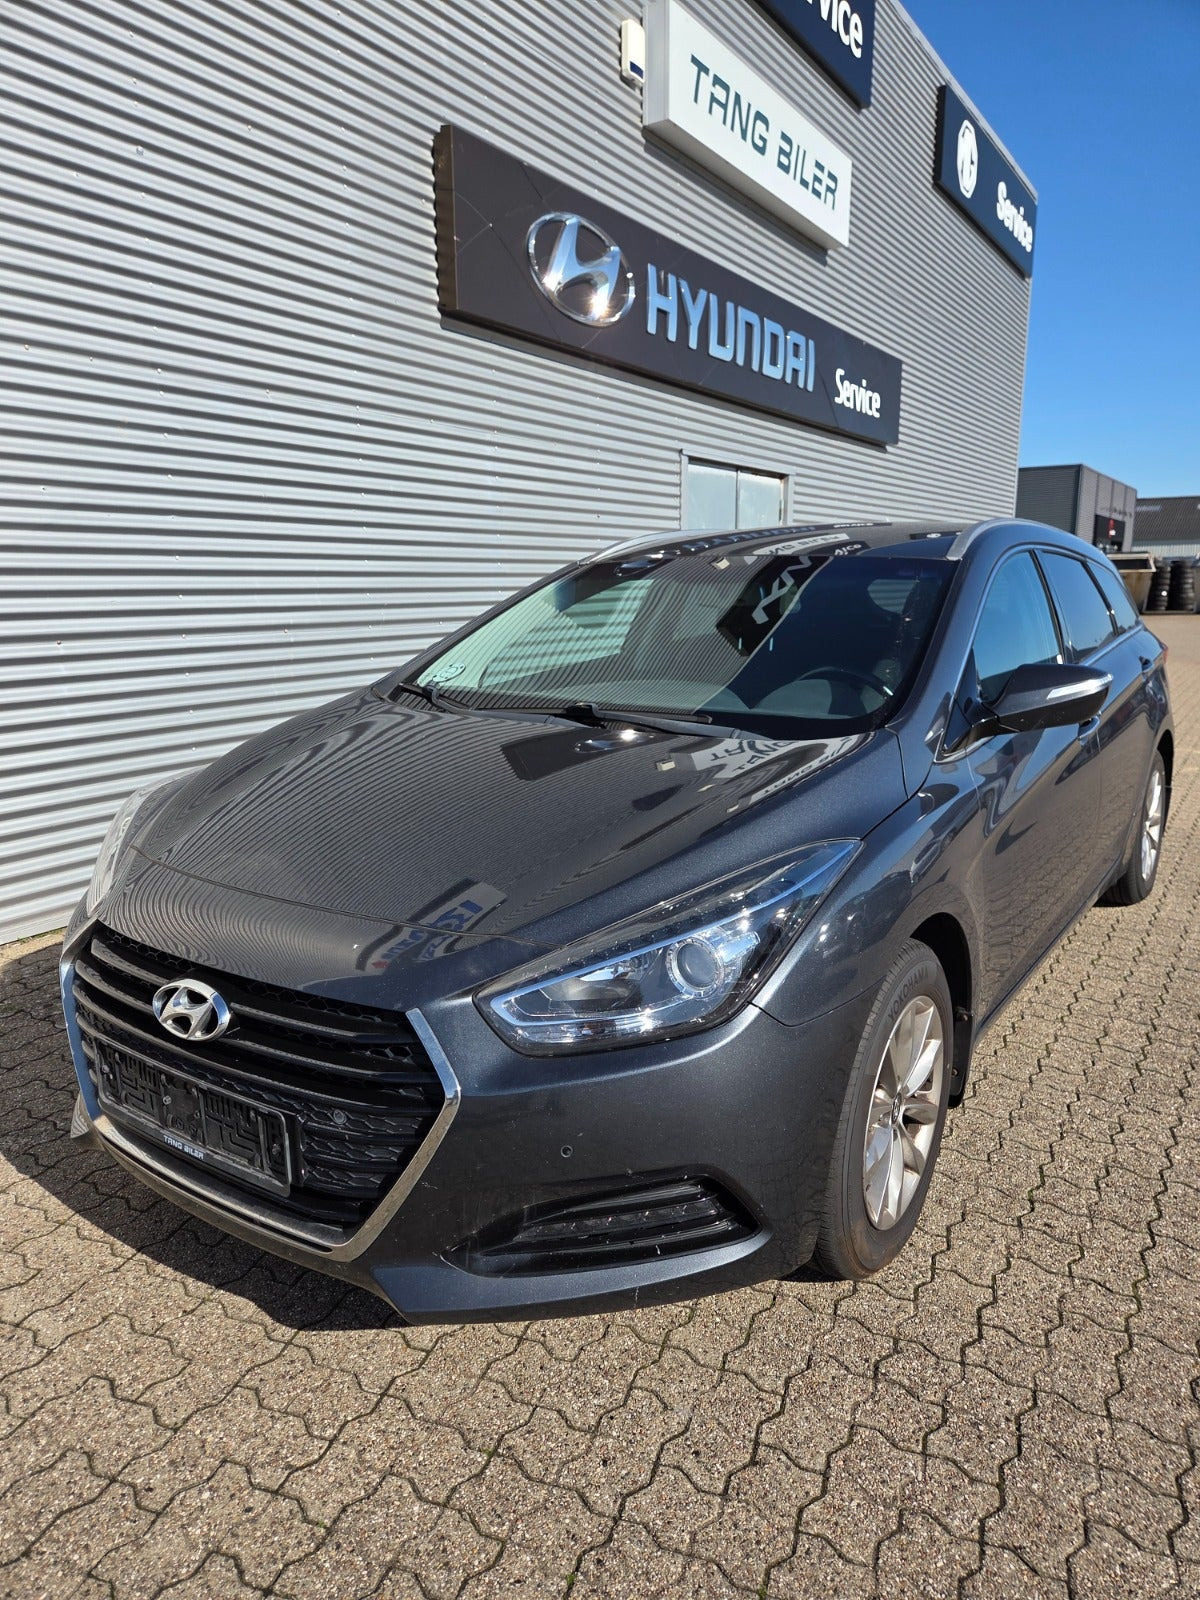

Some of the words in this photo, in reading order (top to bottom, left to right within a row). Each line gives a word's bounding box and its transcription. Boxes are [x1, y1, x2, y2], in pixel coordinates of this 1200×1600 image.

[806, 0, 863, 58] vice
[690, 53, 770, 157] TANG
[776, 130, 838, 211] BILER
[996, 181, 1033, 253] Service
[646, 262, 816, 393] HYUNDAI
[834, 367, 881, 418] Service
[163, 1134, 183, 1150] TANG
[183, 1144, 204, 1160] BILER
